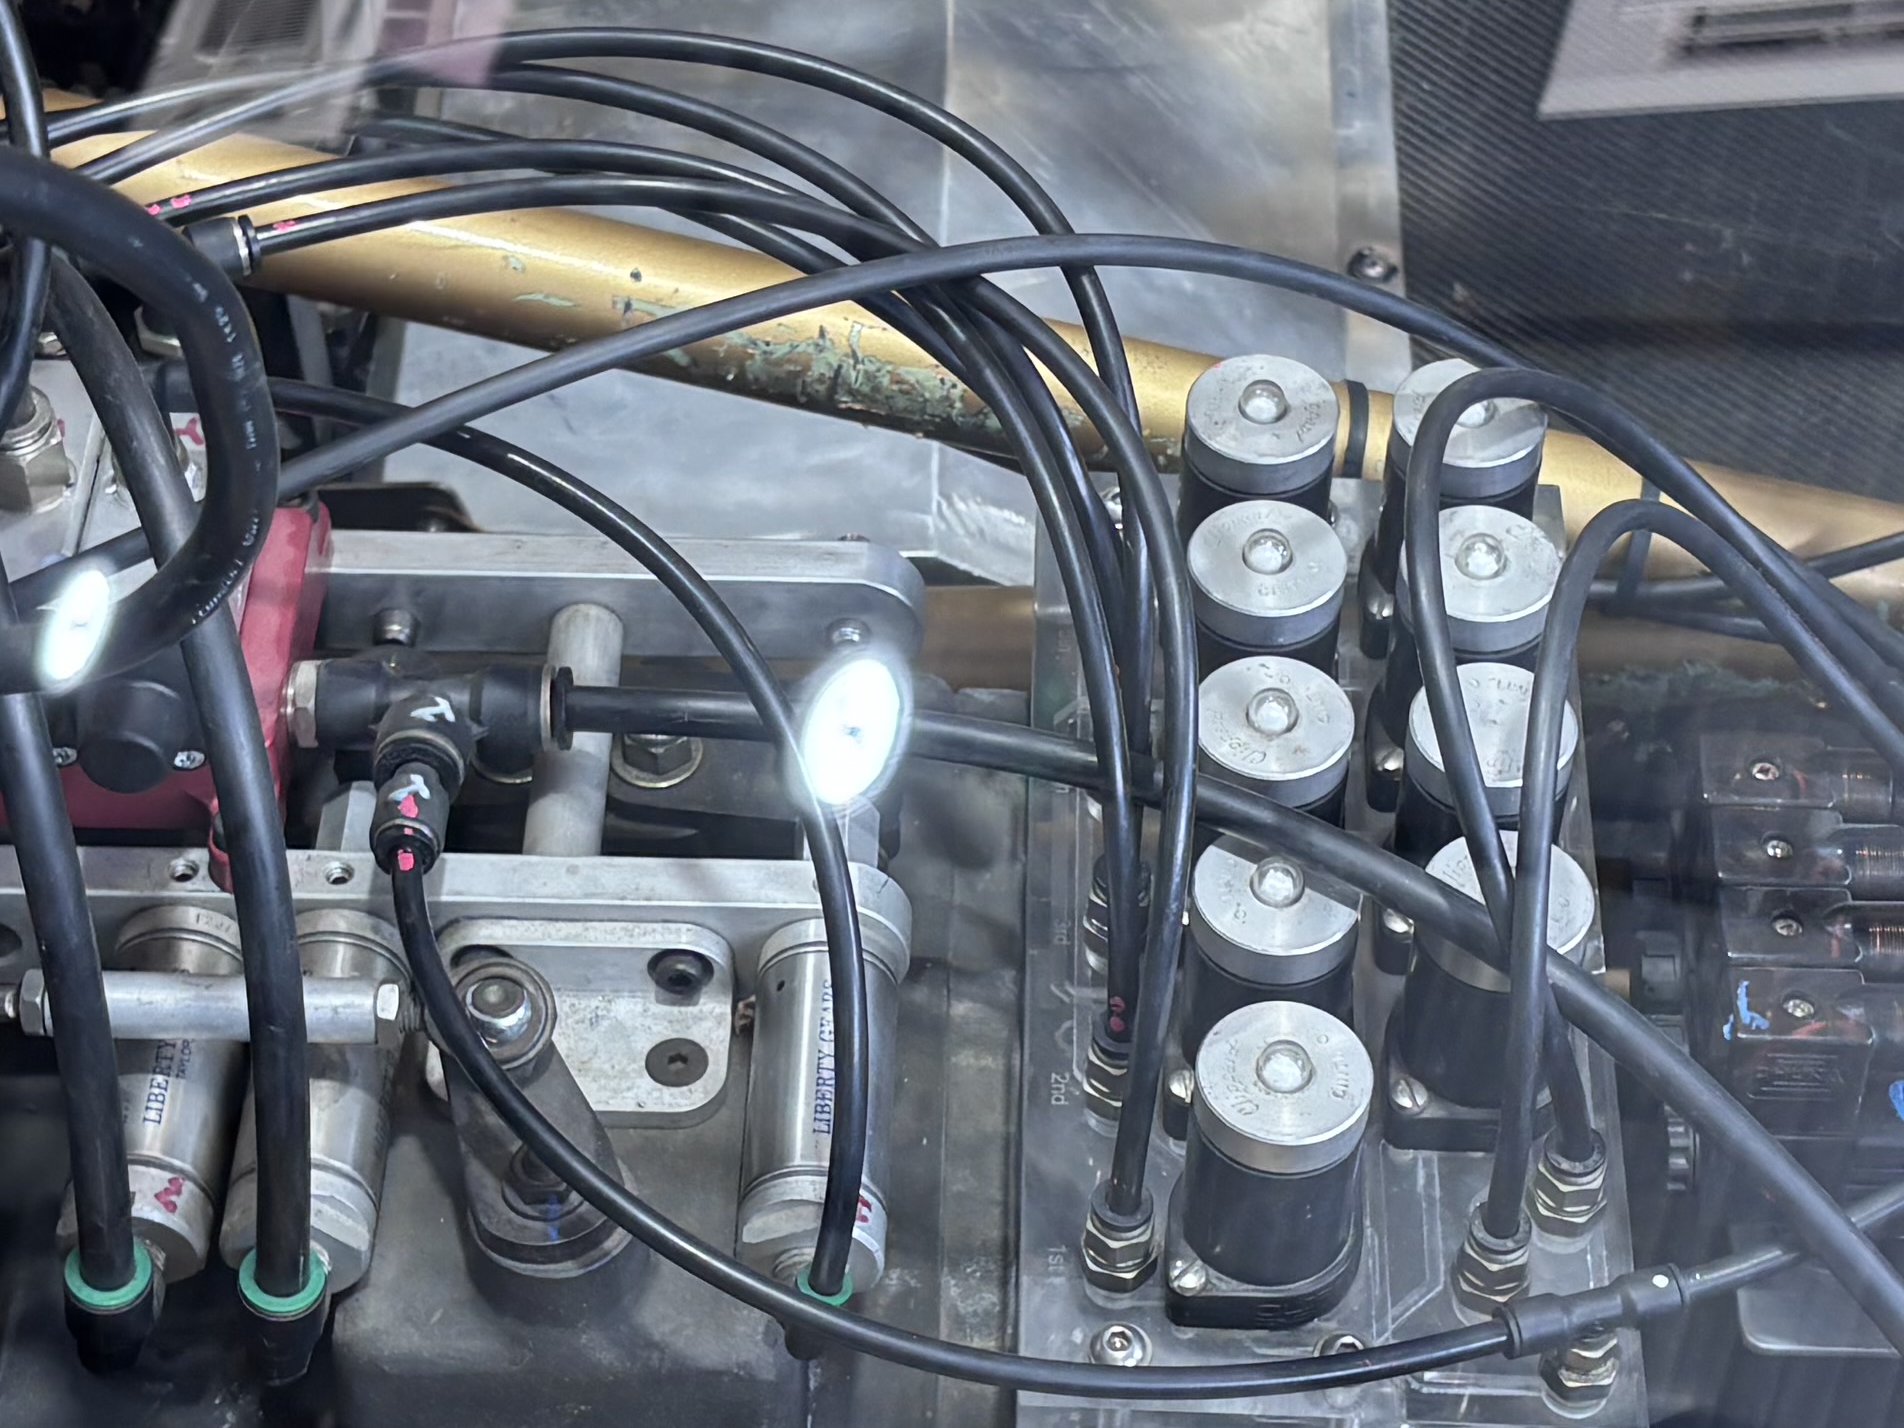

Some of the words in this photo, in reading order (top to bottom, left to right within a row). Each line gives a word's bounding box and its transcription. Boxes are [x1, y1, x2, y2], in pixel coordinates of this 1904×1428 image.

[142, 1038, 178, 1126] LIBERTY
[812, 1049, 836, 1136] LIBERTY
[1049, 1071, 1070, 1106] 2nd
[1047, 1244, 1067, 1283] 1st
